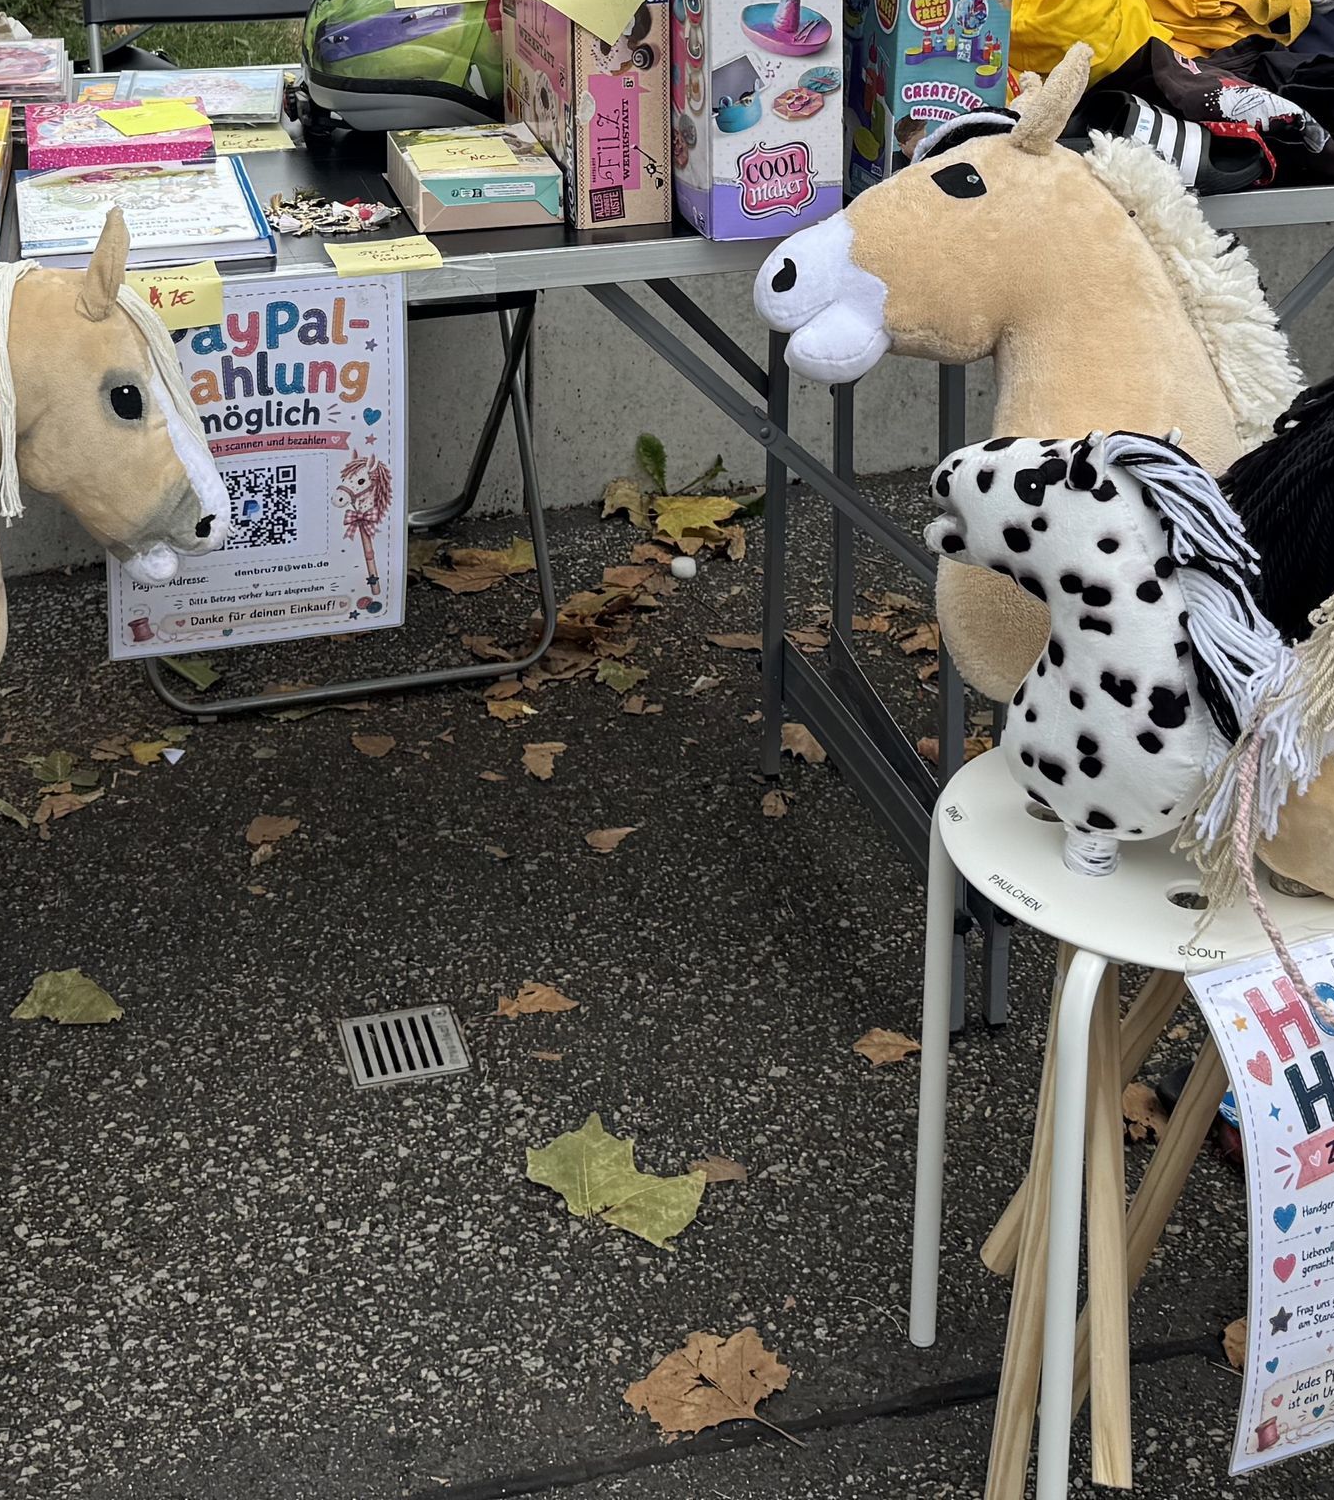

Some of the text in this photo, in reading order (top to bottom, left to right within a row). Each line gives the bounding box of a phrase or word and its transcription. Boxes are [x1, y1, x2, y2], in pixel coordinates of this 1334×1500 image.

[915, 4, 948, 22] FREE!
[903, 84, 957, 104] CREATE
[622, 98, 630, 181] WERKSTATT
[745, 152, 803, 185] COOL
[610, 188, 622, 217] KISTE
[748, 178, 804, 207] maker
[178, 351, 370, 406] ahlung
[224, 439, 265, 452] scannen
[266, 436, 286, 448] und
[287, 435, 328, 448] bezahlen
[189, 585, 325, 606] Bitte Betrag vorher kurz absprechen
[191, 600, 336, 627] Danke für deinen Einkauf!
[944, 804, 964, 823] DINO
[987, 874, 1043, 912] PAULCHEN
[1177, 944, 1227, 961] SCOUT
[1301, 1240, 1334, 1262] Liebevoll
[1301, 1256, 1334, 1278] gemacht
[1296, 1304, 1315, 1318] Frag
[1316, 1300, 1330, 1312] uns
[1297, 1319, 1311, 1331] am
[1291, 1372, 1321, 1394] Jedes
[1287, 1396, 1302, 1411] ist
[1303, 1391, 1319, 1406] ein
